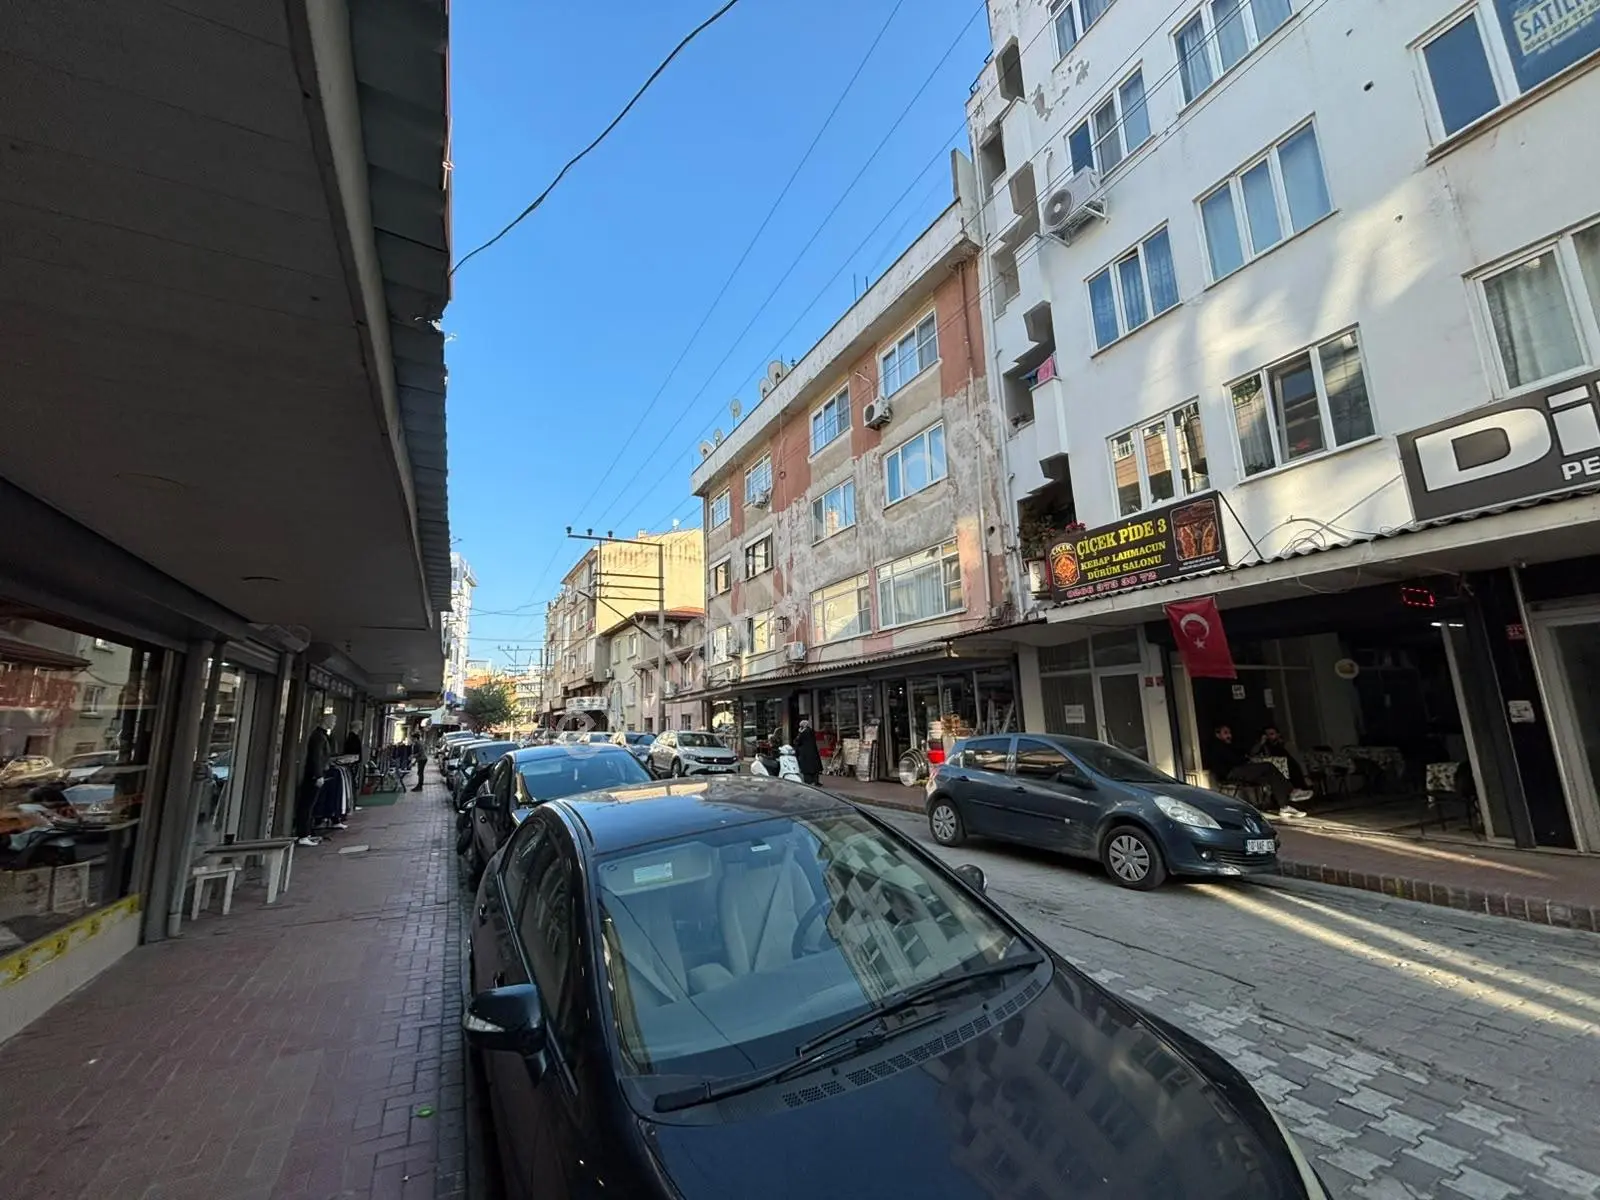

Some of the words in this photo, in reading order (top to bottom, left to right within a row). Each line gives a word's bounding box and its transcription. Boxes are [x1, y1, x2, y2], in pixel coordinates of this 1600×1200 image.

[1077, 531, 1118, 559] ÇİÇEK
[1118, 520, 1154, 544] PİDE
[1157, 519, 1167, 533] 3
[1081, 556, 1110, 570] KEBAP
[1112, 541, 1166, 561] LAHMACUN
[1087, 564, 1121, 580] DÜRÜM
[1123, 555, 1162, 572] SALONU
